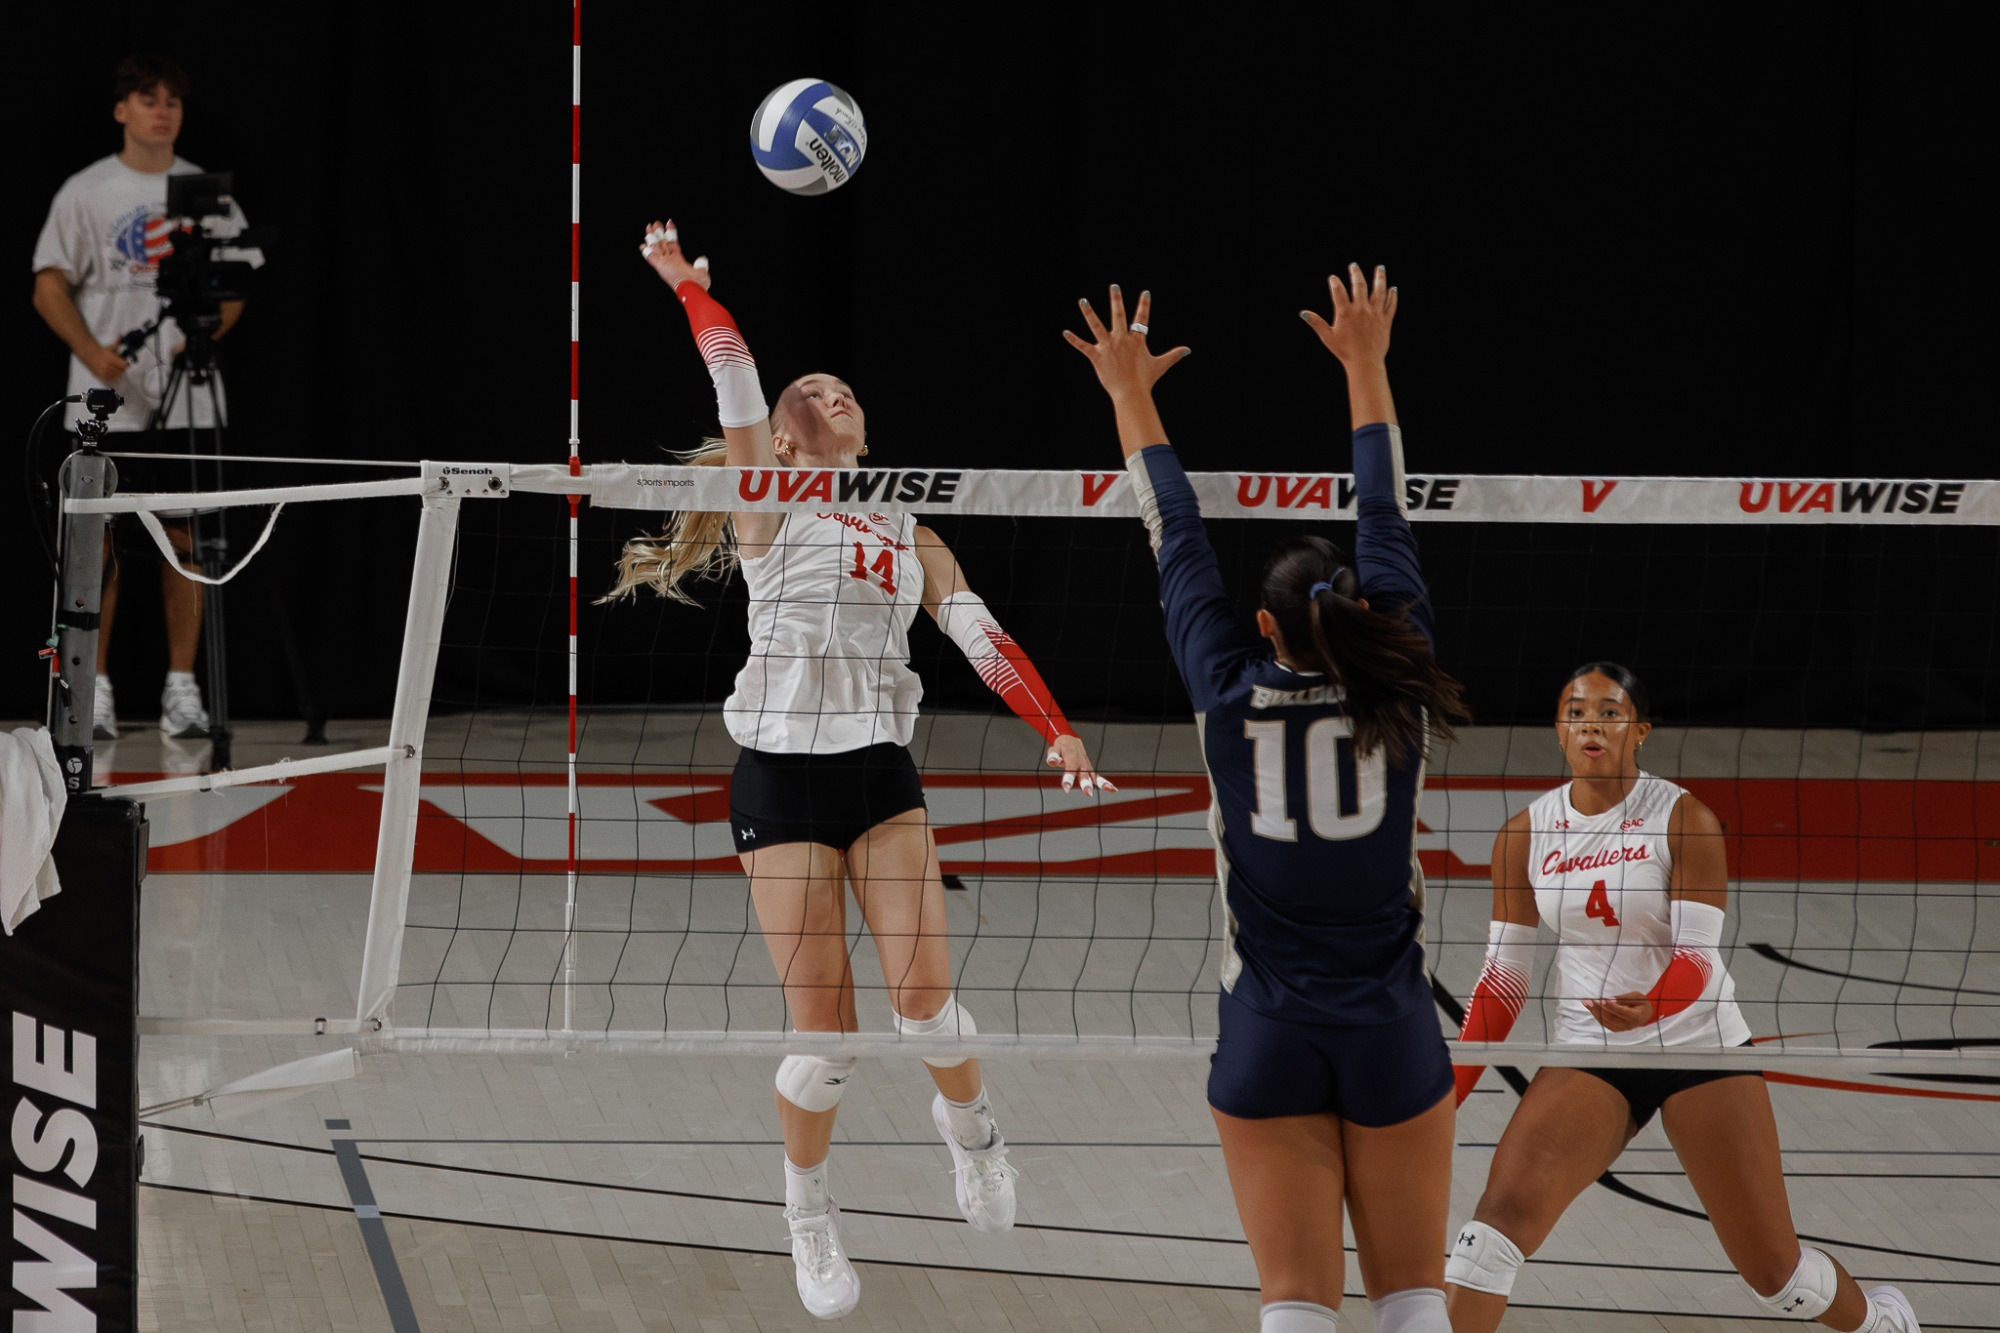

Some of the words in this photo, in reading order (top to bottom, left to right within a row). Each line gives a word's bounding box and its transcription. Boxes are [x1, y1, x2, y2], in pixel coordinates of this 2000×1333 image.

[809, 137, 847, 184] molten
[451, 467, 493, 475] Senoh
[636, 478, 662, 487] sports
[738, 469, 961, 504] UVAWISE
[1080, 473, 1120, 506] V
[1237, 475, 1461, 511] UVASE
[1580, 480, 1619, 513] V
[1738, 481, 1965, 514] UVAWISE
[849, 541, 897, 596] 14
[1243, 715, 1388, 843] 10
[1621, 817, 1645, 831] SAC
[1542, 843, 1650, 876] Cavaliers
[1585, 879, 1620, 928] 4
[11, 1010, 99, 1333] WISE
